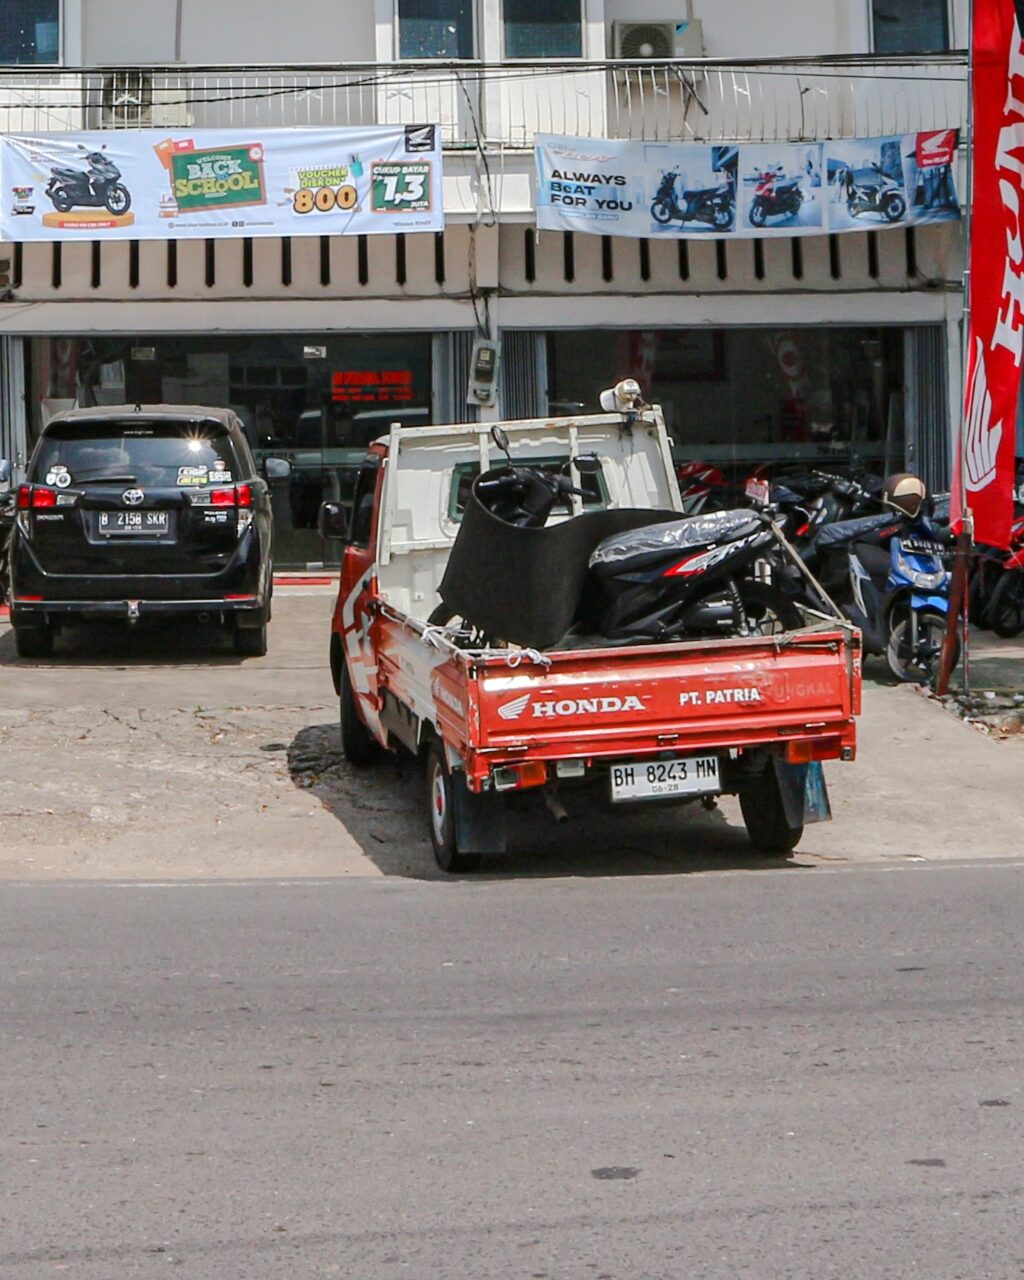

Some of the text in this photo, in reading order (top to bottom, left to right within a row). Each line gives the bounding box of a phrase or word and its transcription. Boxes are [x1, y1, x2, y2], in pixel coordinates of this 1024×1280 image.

[186, 159, 243, 180] BACK
[298, 168, 348, 179] VOUCHER
[373, 165, 429, 174] CUKUP BAYAR
[551, 169, 627, 186] ALWAYS
[175, 171, 259, 197] SCHOOL
[383, 174, 425, 205] 1,3
[293, 184, 358, 214] 800
[550, 194, 633, 211] FOR YOU
[101, 512, 108, 526] B
[147, 512, 166, 525] SKR
[532, 696, 646, 717] HONDA
[679, 692, 702, 706] PT.
[706, 688, 761, 704] PATRIA
[614, 758, 717, 787] BH 8243 MN
